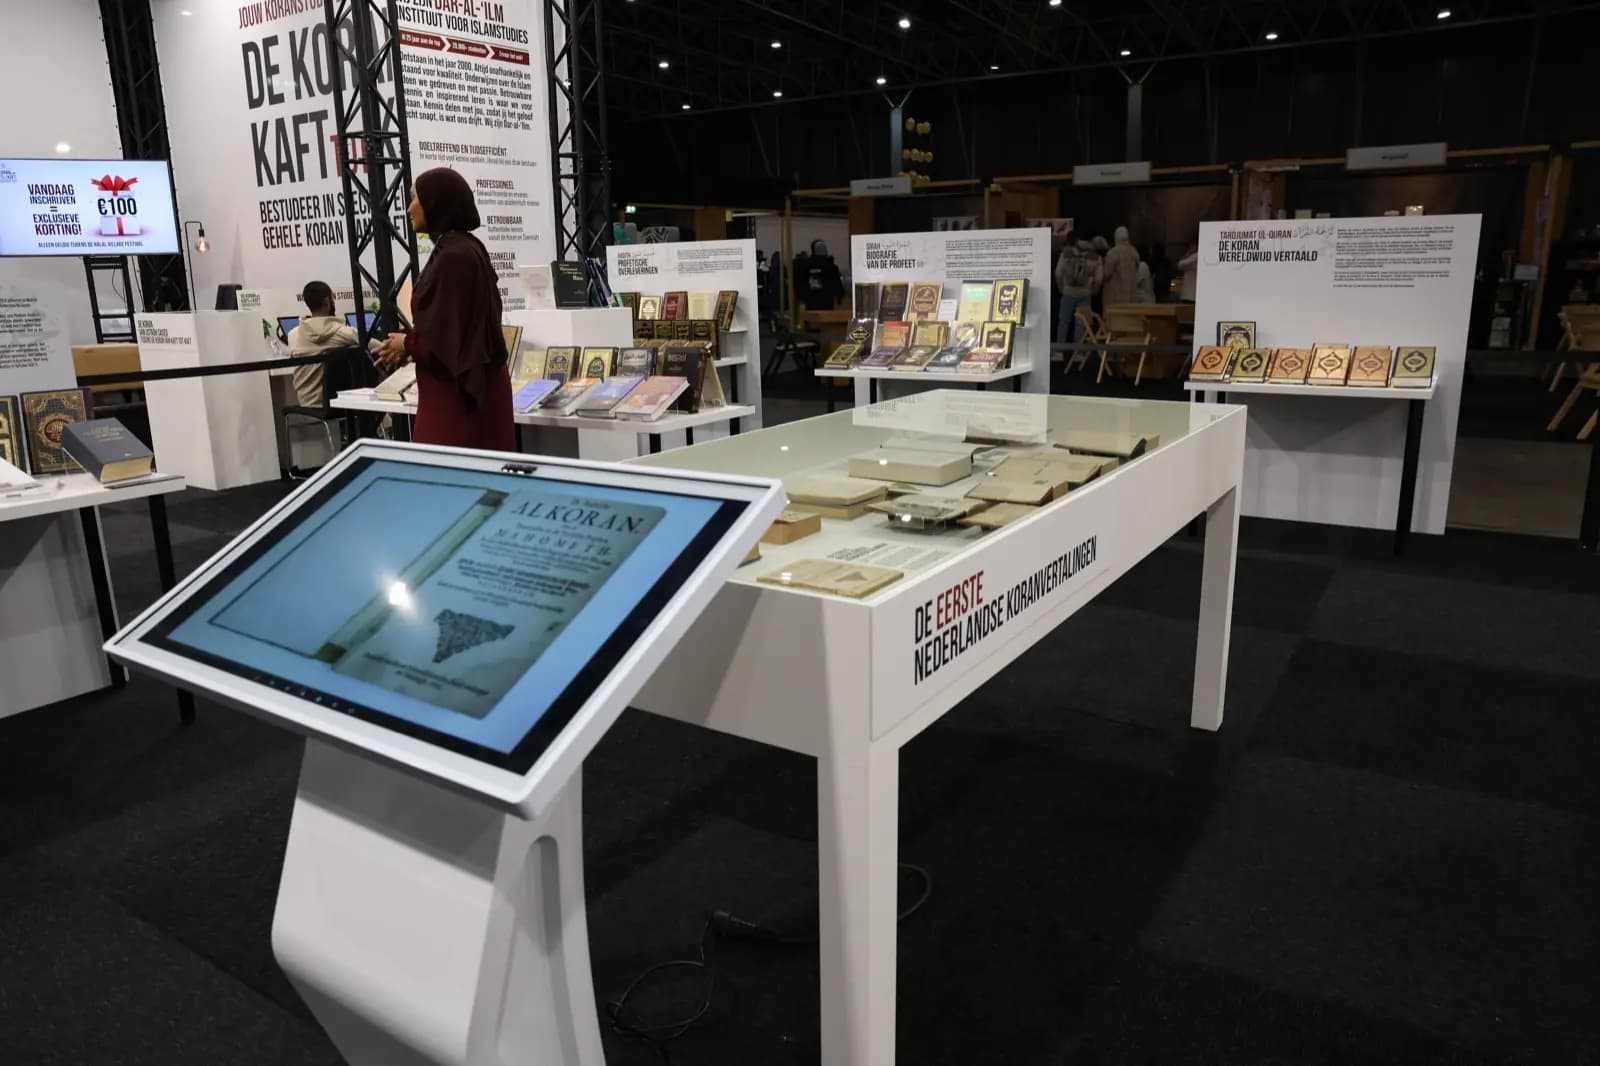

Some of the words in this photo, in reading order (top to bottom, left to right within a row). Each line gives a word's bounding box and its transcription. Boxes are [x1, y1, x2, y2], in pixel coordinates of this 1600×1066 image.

[239, 2, 263, 29] JOUW
[398, 4, 442, 28] NSTITUUT
[445, 14, 469, 32] VOOR
[470, 19, 528, 44] ISLAMSTUDIES
[428, 56, 434, 65] in
[434, 56, 444, 66] het
[445, 58, 456, 69] jaar
[242, 35, 285, 110] DE
[423, 68, 436, 76] voor
[251, 109, 328, 187] KAFT
[28, 184, 74, 196] VANDAAG
[476, 179, 514, 189] PROFESSIONEEL
[30, 196, 76, 205] INSCHRIJVEN
[97, 198, 137, 216] €100
[260, 195, 321, 224] BESTUDEER
[322, 192, 335, 218] IN
[33, 214, 80, 223] EXCLUSIEVE
[487, 215, 522, 224] BETROUWBAAR
[35, 224, 82, 236] KORTING!
[262, 224, 302, 249] GEHELE
[306, 220, 344, 246] KORAN
[1219, 240, 1230, 251] DE
[1231, 240, 1260, 251] KORAN
[866, 250, 897, 259] BIOGRAFIE
[1219, 251, 1272, 262] WERELDWIJD
[1273, 250, 1318, 262] VERTAALD
[618, 258, 648, 266] PROFETISCHE
[866, 260, 879, 269] VAN
[880, 260, 888, 268] DE
[889, 259, 916, 268] PROFEET
[618, 266, 658, 276] OVERLEVERINGEN
[914, 595, 1004, 686] NEDERLANDSE
[1006, 535, 1097, 622] KORANVERTALINGEN
[915, 600, 933, 644] DE
[936, 570, 984, 630] EERSTE
